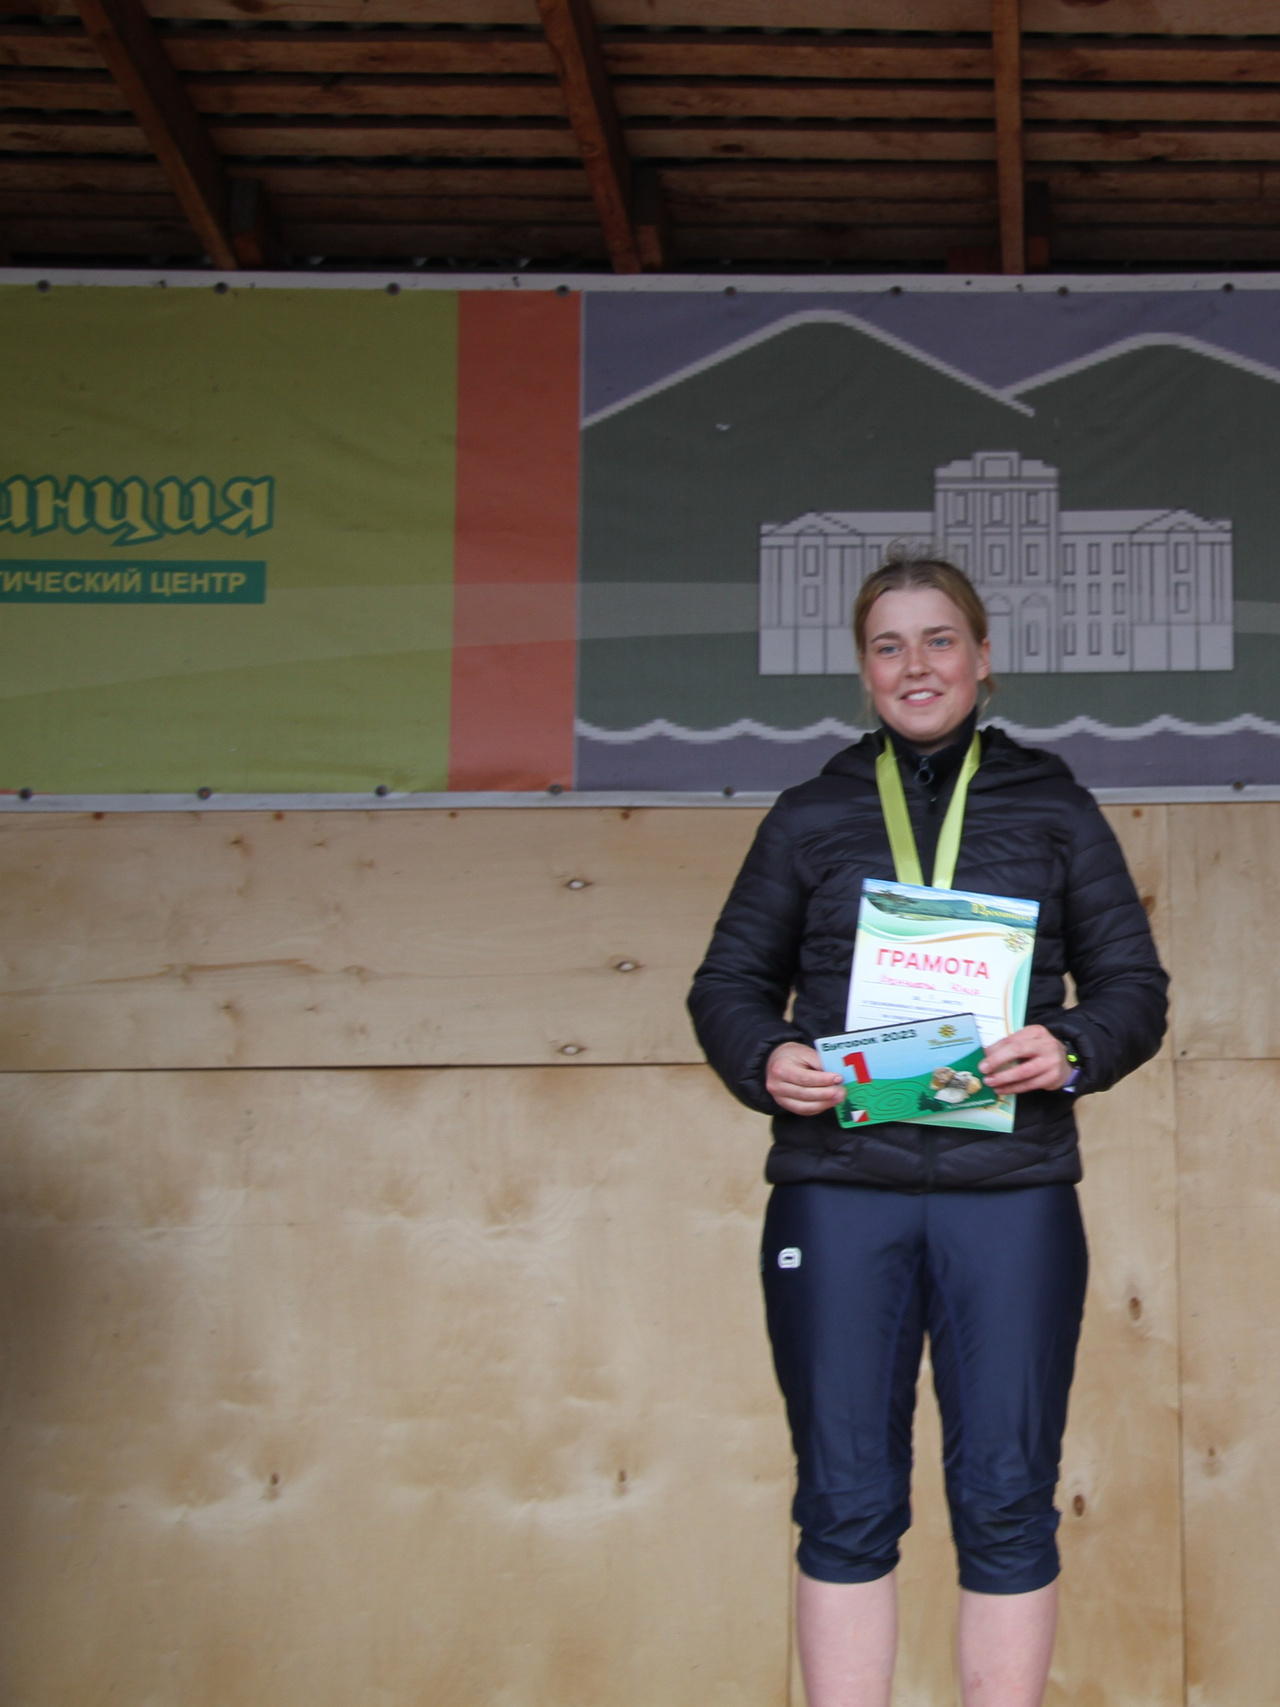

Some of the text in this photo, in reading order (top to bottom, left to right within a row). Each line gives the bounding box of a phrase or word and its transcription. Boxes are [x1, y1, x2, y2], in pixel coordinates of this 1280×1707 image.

[0, 568, 246, 596] ИЧЕСКИЙ ЦЕНТР
[876, 948, 990, 979] ГРАМОТА
[880, 1029, 918, 1042] 2023
[842, 1051, 872, 1084] 1
